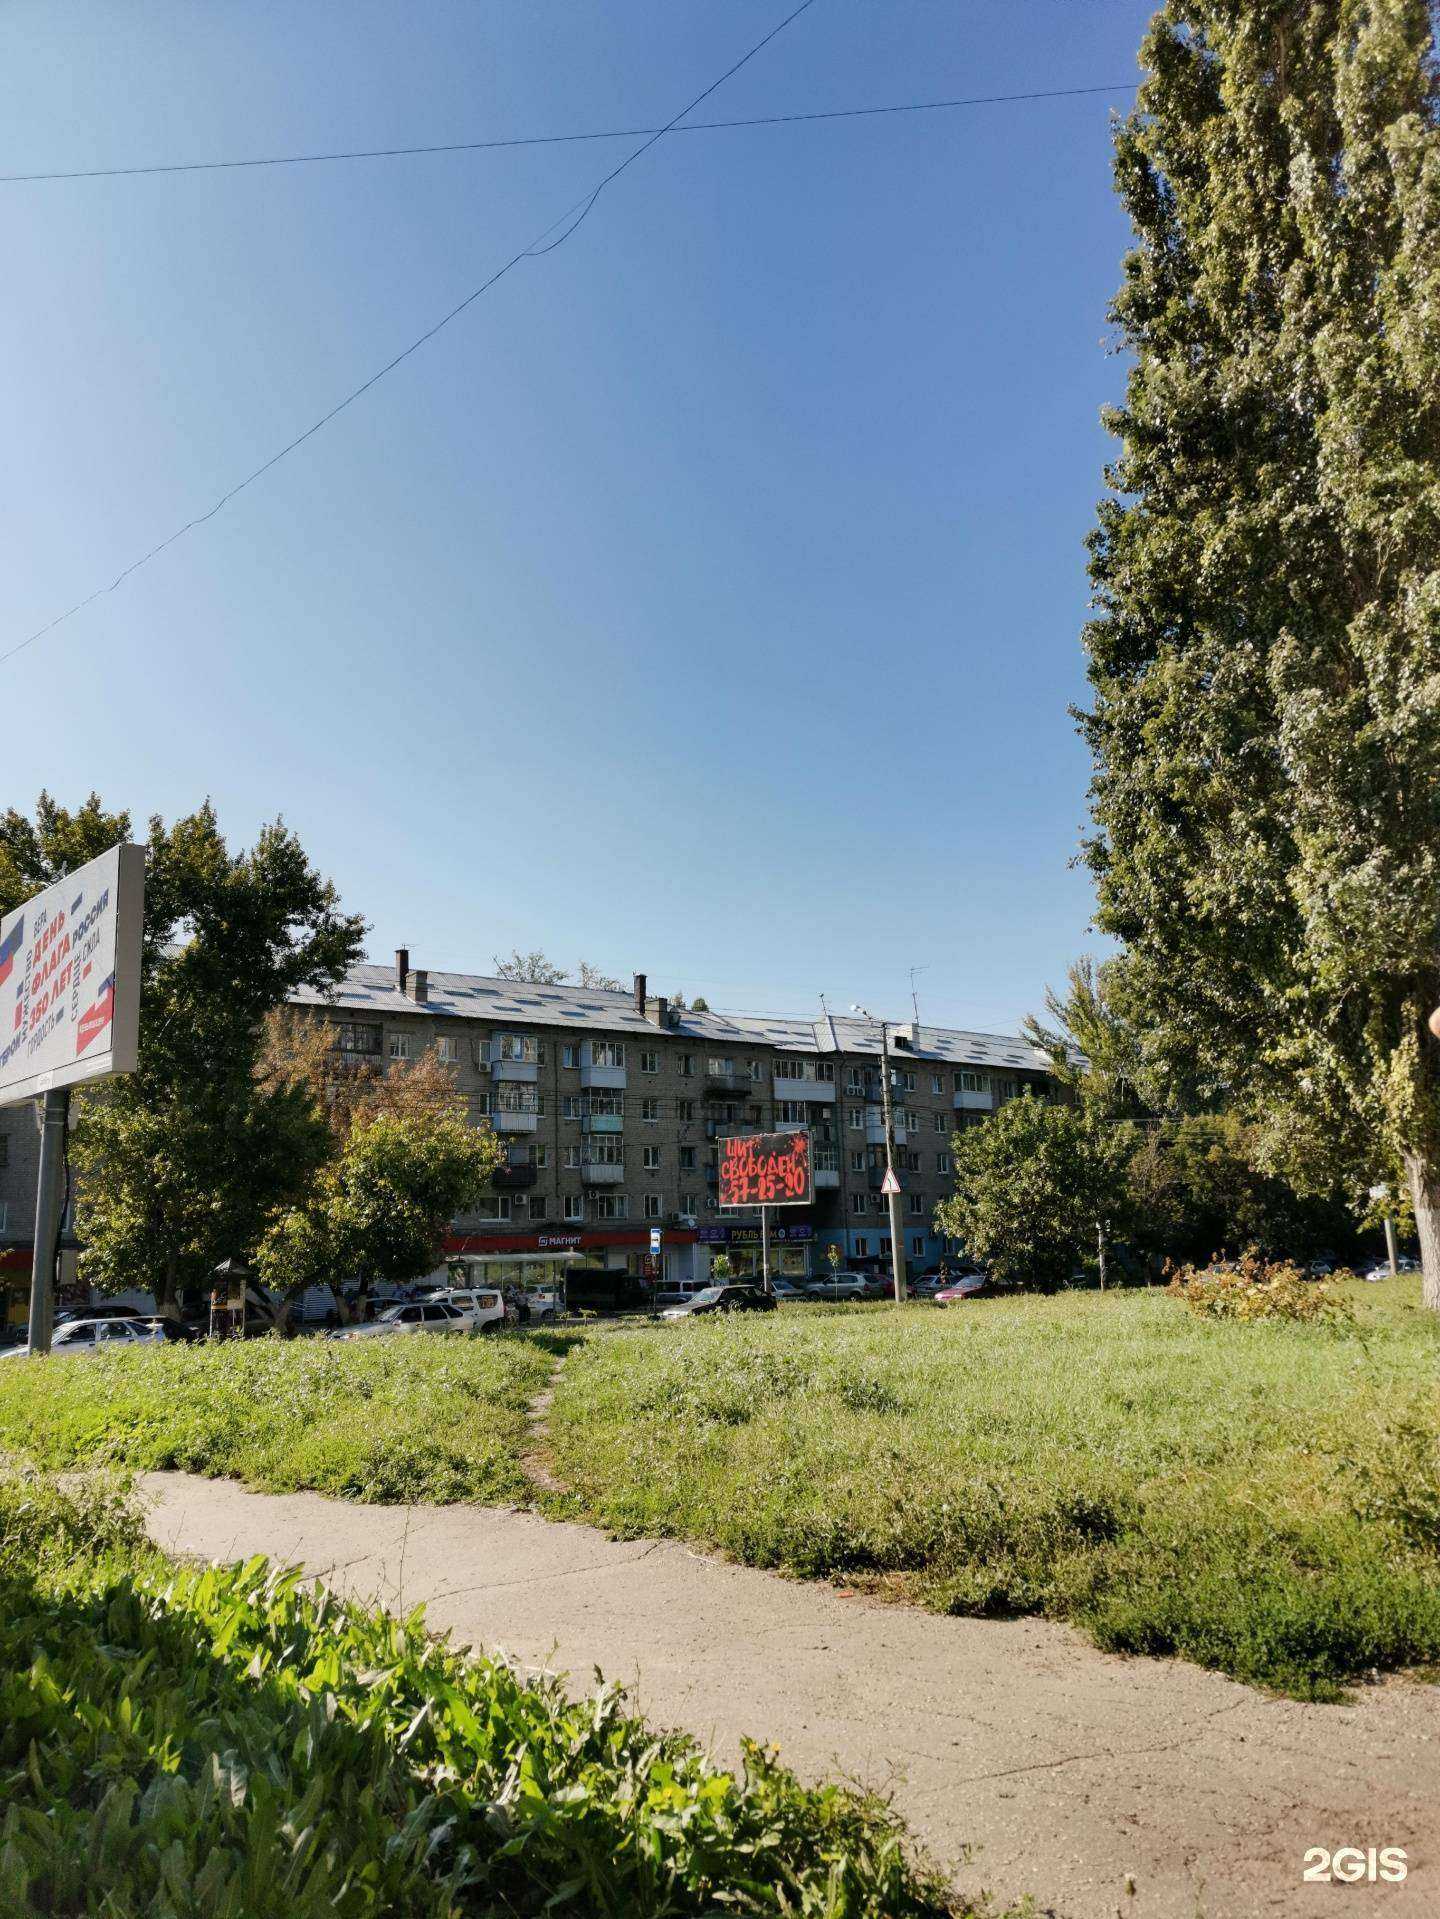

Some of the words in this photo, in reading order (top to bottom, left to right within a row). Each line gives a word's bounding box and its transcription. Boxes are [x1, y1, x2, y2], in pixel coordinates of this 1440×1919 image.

[32, 933, 70, 995] ФЛАГА
[33, 910, 65, 967] ДЕНЬ
[22, 950, 32, 1043] МУЖЕСТВО
[30, 992, 49, 1031] 350
[51, 960, 73, 1005] ЛЕТ
[71, 952, 80, 1022] СЕРДЦЕ
[721, 1153, 797, 1180] СВОБОДЕН
[726, 1138, 754, 1159] ЩИТ
[549, 1236, 581, 1246] МАГНИТ
[732, 1229, 759, 1240] РУБЛЬ
